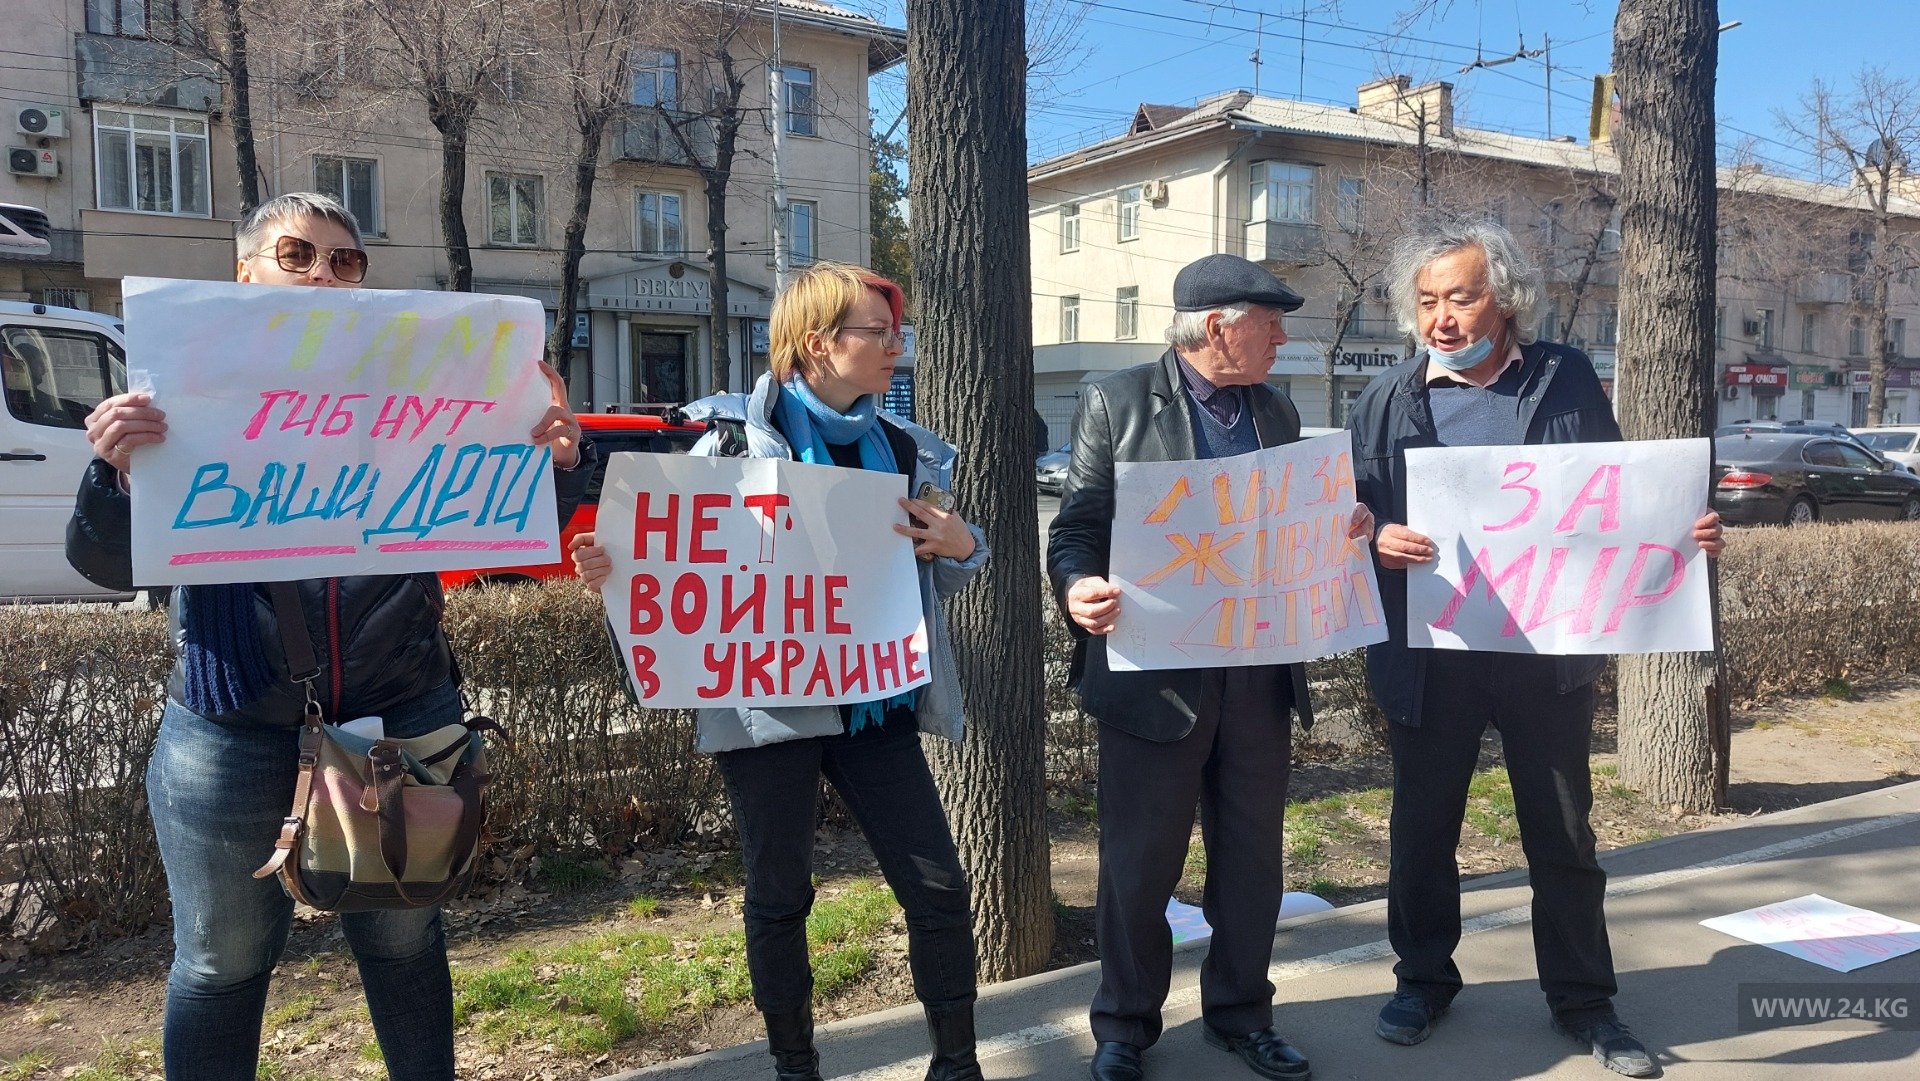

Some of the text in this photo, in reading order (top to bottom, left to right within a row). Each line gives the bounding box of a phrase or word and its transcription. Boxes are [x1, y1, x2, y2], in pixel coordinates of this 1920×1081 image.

[268, 310, 516, 396] ТАМ
[1334, 346, 1398, 372] Esquire
[242, 389, 498, 443] ГИБНУТ
[172, 443, 551, 544] ВАШИ ДЕТИ
[1143, 451, 1353, 526] МЫ ЗА
[1482, 461, 1622, 534] ЗА
[633, 491, 790, 564] НЕТ
[1134, 512, 1366, 588] ЖИВЫХ
[629, 564, 852, 635] ВОЙНЕ
[1169, 568, 1380, 658] ДЕТЕЙ
[1431, 542, 1686, 638] МИР
[631, 633, 926, 699] В УКРАИНЕ
